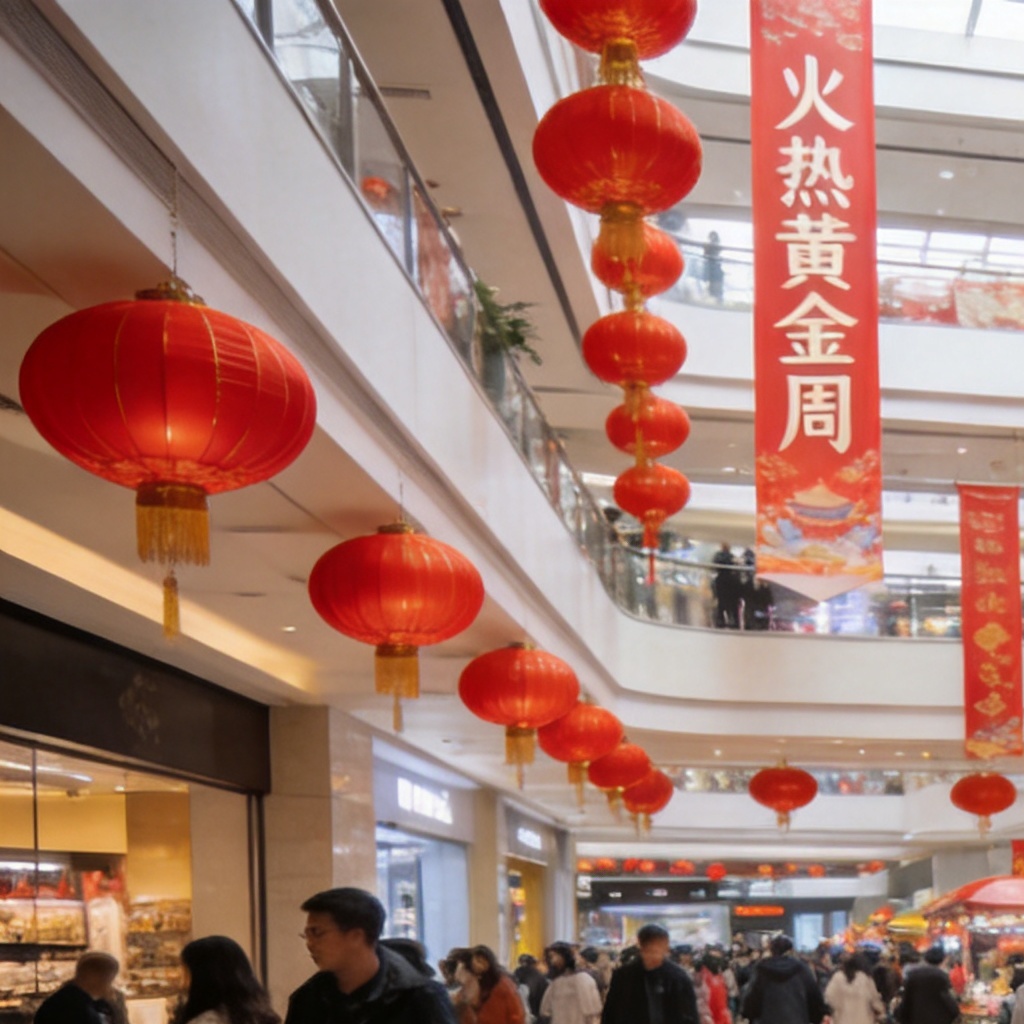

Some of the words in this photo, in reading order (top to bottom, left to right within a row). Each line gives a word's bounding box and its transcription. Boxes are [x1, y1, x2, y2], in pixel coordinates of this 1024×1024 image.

[774, 53, 858, 454] 火热黄金周
